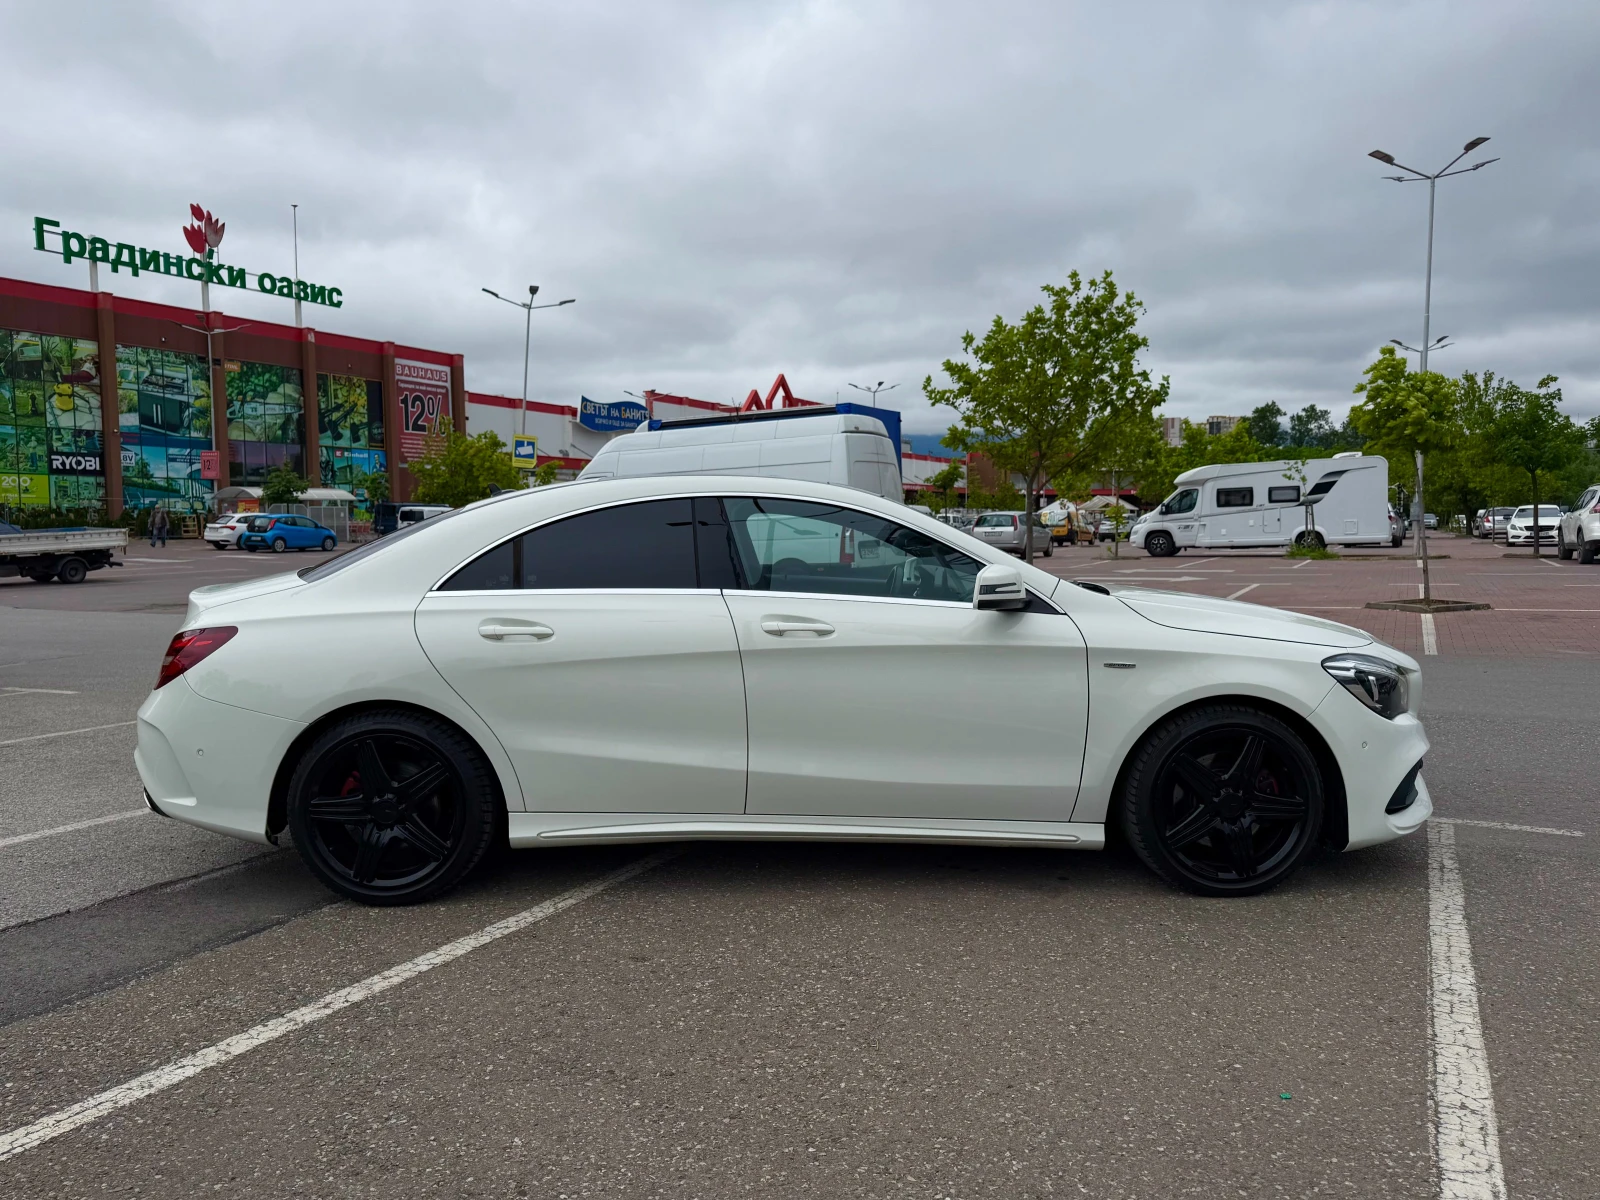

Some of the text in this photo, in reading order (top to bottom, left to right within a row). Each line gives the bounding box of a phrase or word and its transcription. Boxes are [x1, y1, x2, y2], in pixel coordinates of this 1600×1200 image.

[34, 216, 343, 309] Градински оазис
[396, 364, 447, 381] BAUHAUS
[399, 391, 447, 437] 12%
[582, 401, 609, 416] СВЕТЪТ
[611, 407, 620, 417] НА
[51, 455, 100, 470] RYOBI
